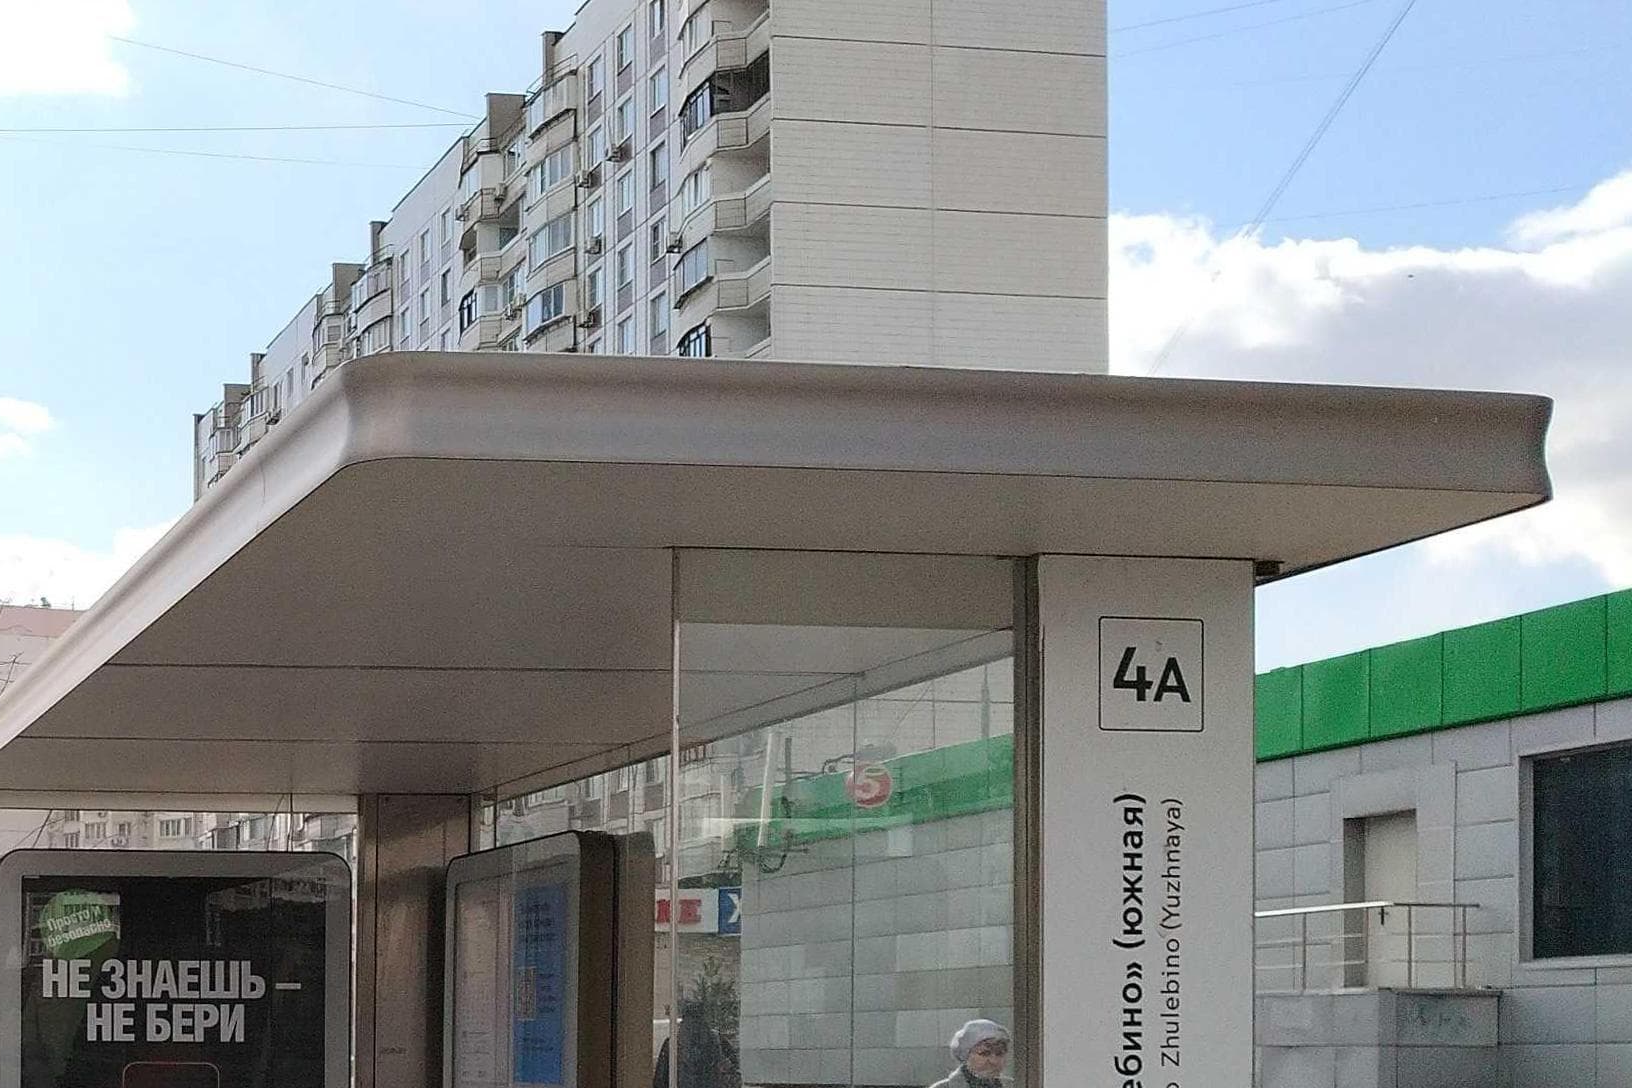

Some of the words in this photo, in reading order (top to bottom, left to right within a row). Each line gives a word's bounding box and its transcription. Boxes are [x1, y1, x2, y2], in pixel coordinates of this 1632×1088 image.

[1113, 646, 1191, 703] 4А
[1113, 793, 1147, 950] (южная)
[1159, 798, 1186, 930] (Yuzhnaya)
[42, 959, 91, 998] НЕ
[101, 959, 266, 999] ЗНАЕШЬ
[87, 1004, 135, 1042] НЕ
[146, 1004, 245, 1043] БЕРИ
[1159, 938, 1181, 1067] Zhulebino
